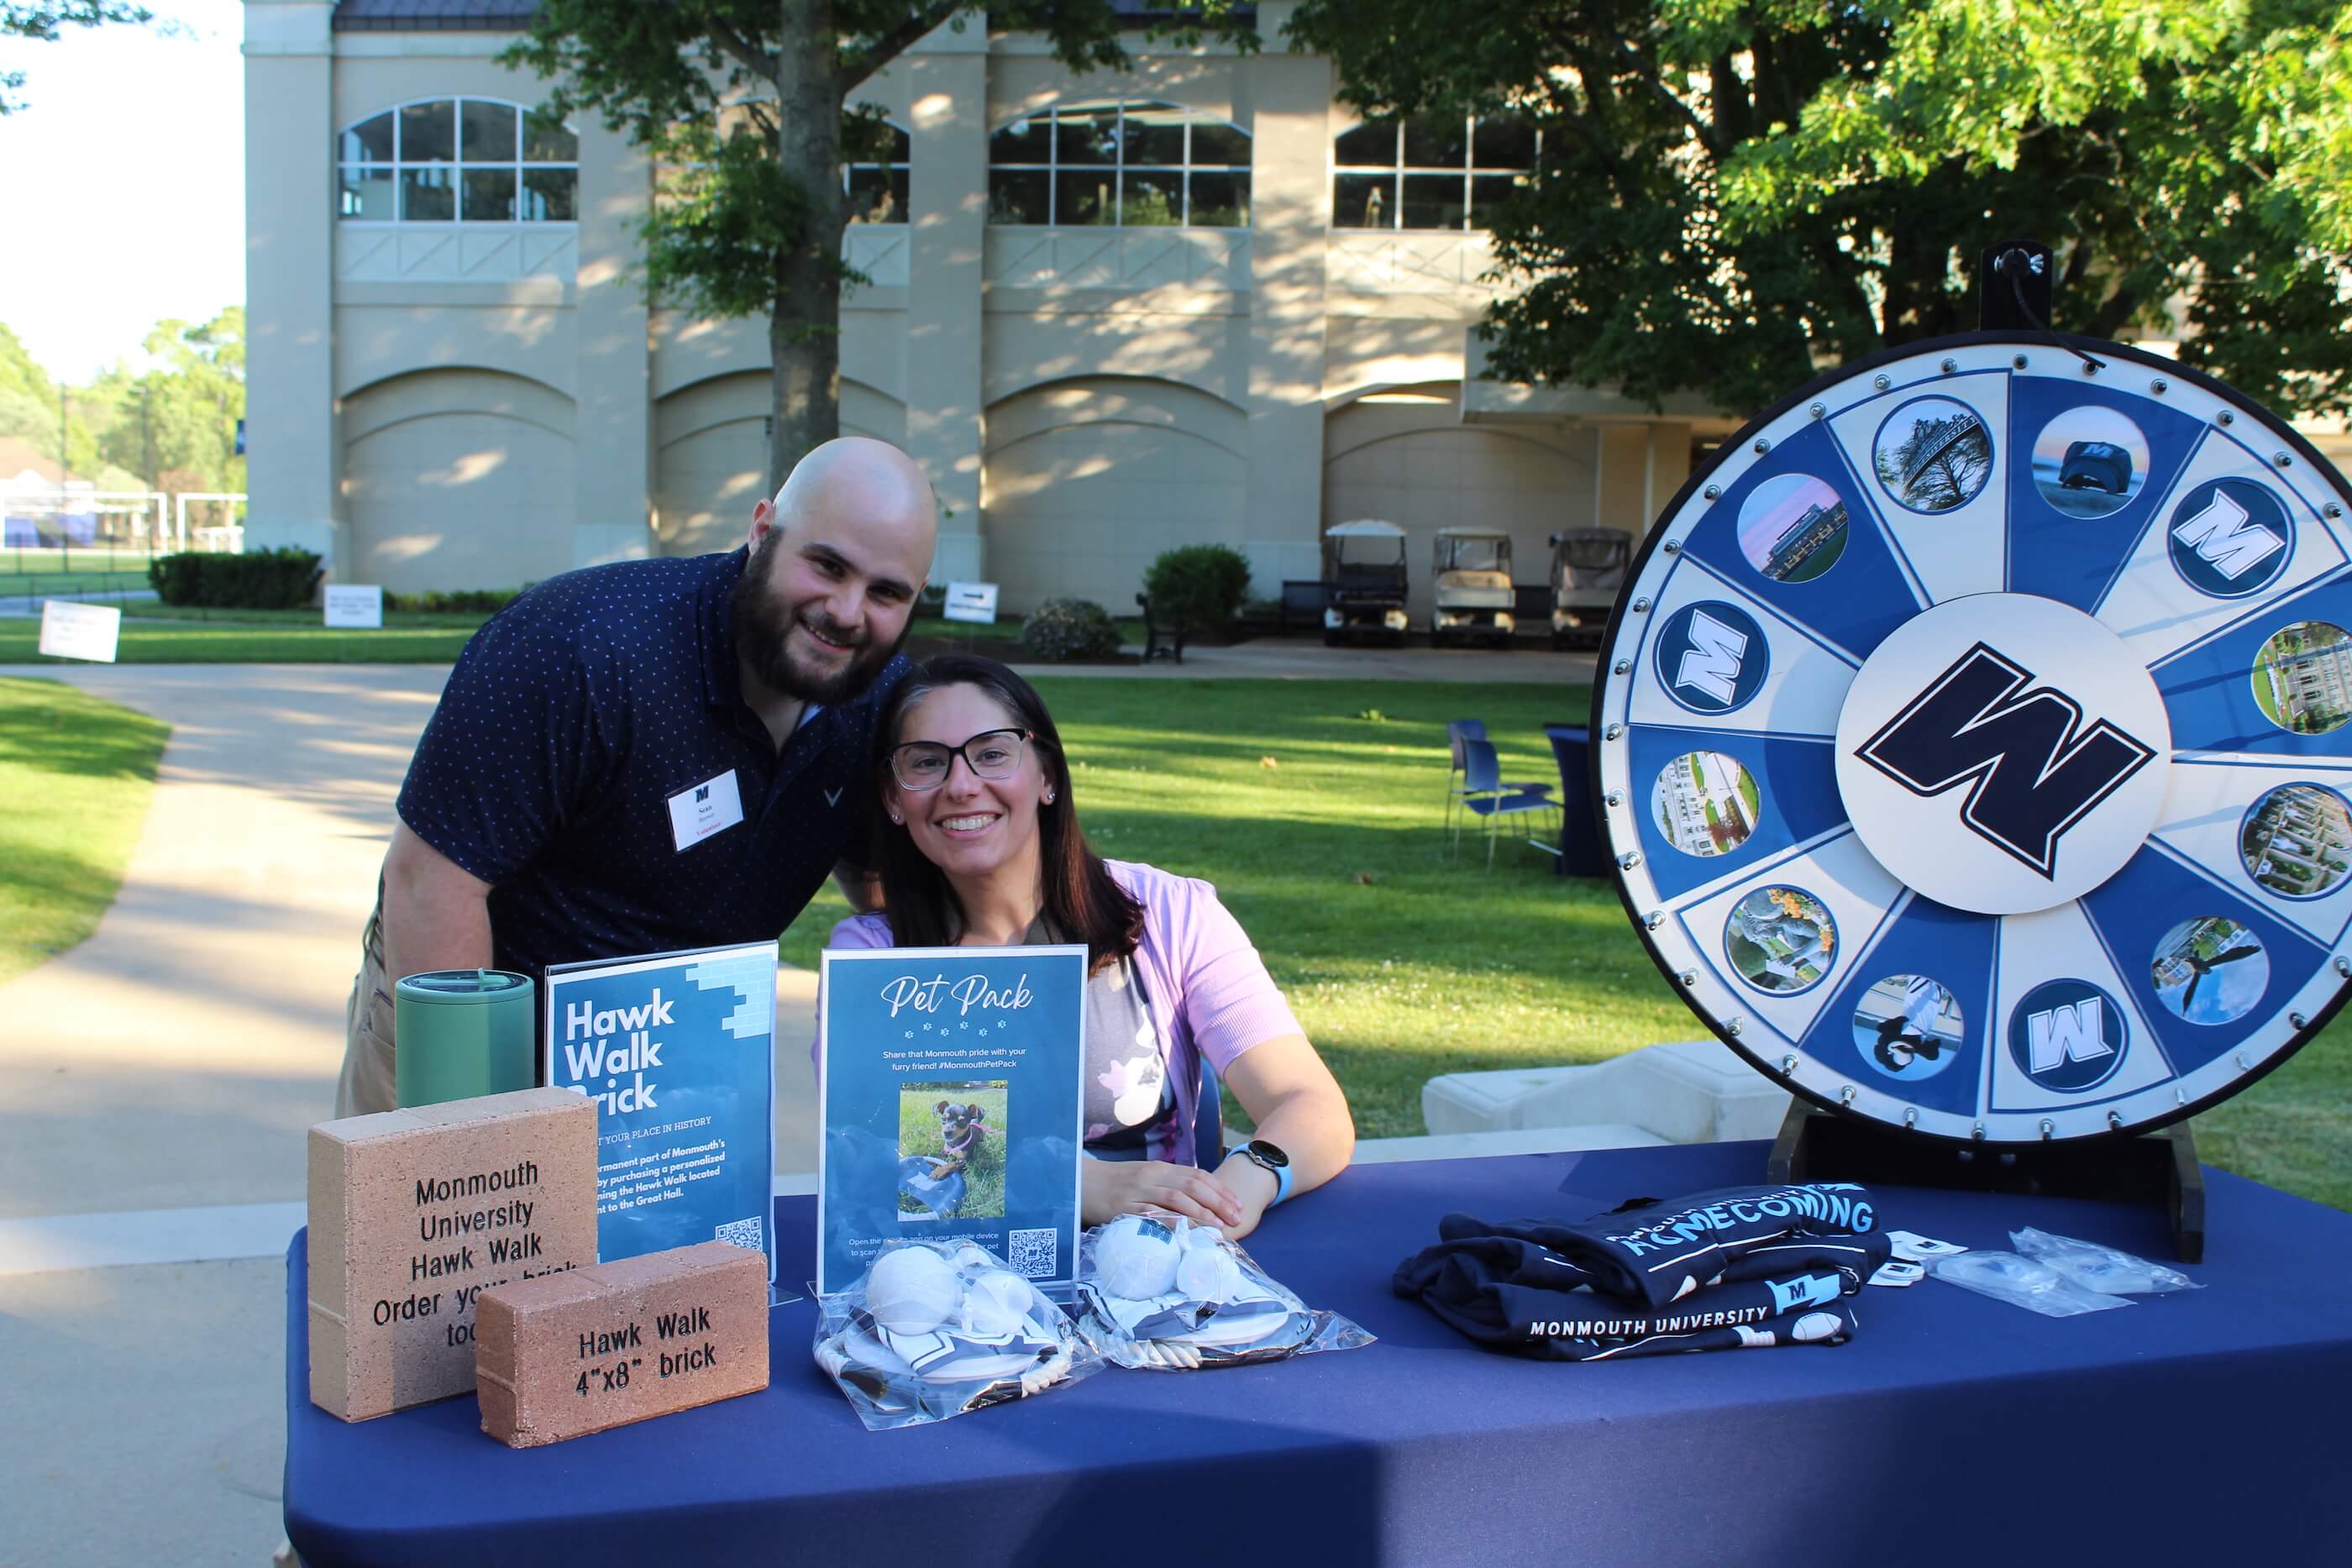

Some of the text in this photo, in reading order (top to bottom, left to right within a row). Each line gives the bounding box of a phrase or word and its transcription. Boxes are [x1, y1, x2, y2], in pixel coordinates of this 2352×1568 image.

[2171, 487, 2286, 581] M
[1674, 608, 1748, 705] M
[695, 784, 709, 803] M
[880, 973, 1034, 1018] Pet Pack
[567, 988, 675, 1041] Hawk
[564, 1030, 664, 1081] Walk
[883, 1046, 1026, 1059] Share that Monmouth pride with your
[892, 1060, 1017, 1072] furry friend! #MonmouthPetPack
[606, 1133, 630, 1145] YOUR
[632, 1126, 660, 1138] PLACE
[663, 1124, 672, 1134] IN
[674, 1116, 712, 1131] HISTORY
[597, 1176, 608, 1188] by
[610, 1167, 660, 1187] purchasing
[669, 1151, 726, 1174] personalized
[640, 1152, 659, 1167] part
[661, 1148, 671, 1160] of
[671, 1139, 726, 1158] Monmouth's
[416, 1160, 538, 1208] Monmouth
[619, 1184, 634, 1196] the
[635, 1178, 663, 1193] Hawk
[663, 1172, 687, 1187] Walk
[689, 1166, 721, 1182] located
[607, 1203, 617, 1212] to
[619, 1198, 634, 1210] the
[636, 1193, 663, 1206] Great
[663, 1187, 684, 1200] Hall.
[420, 1200, 533, 1242] University
[848, 1238, 869, 1246] Open
[951, 1232, 974, 1240] mobile
[412, 1232, 542, 1282] Hawk Walk
[1788, 1282, 1805, 1300] M
[373, 1293, 441, 1325] Order
[1530, 1306, 1769, 1337] MONMOUTH UNIVERSITY
[579, 1307, 711, 1359] Hawk Walk
[660, 1342, 717, 1378] brick
